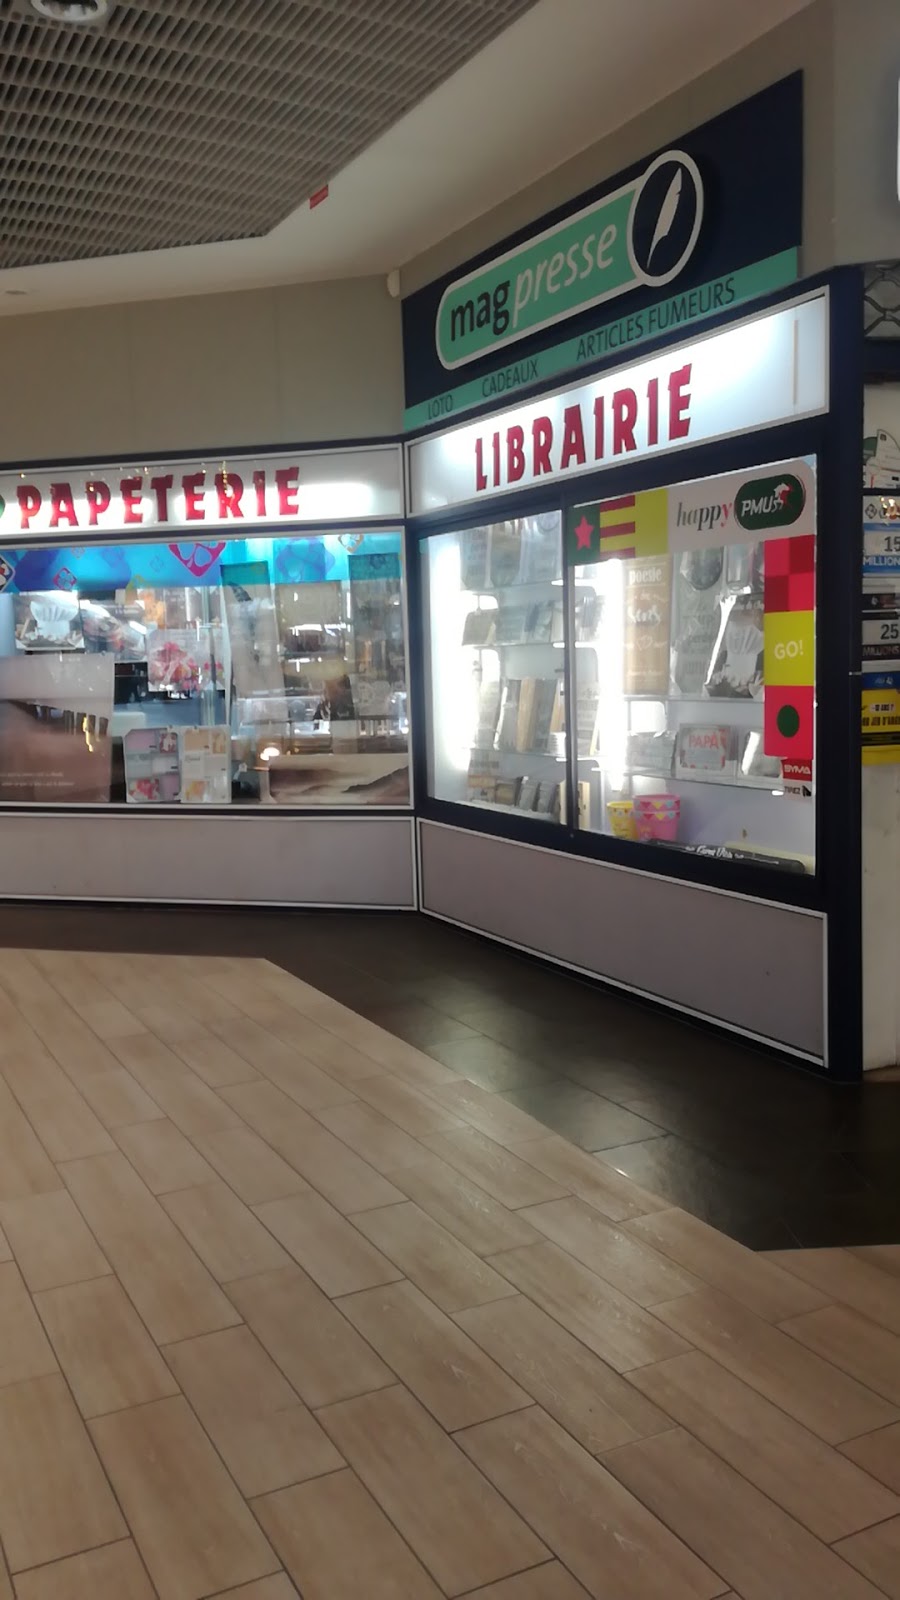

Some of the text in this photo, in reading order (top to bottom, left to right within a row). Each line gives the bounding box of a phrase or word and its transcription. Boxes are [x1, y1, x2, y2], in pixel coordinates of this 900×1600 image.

[427, 276, 736, 420] LOTO CADEAUX ARTICLES FUMEURS
[474, 363, 693, 493] LIBRAIRIE
[16, 467, 300, 529] PAPETERIE
[677, 502, 733, 531] happy
[774, 640, 804, 661] GO!
[880, 624, 899, 640] 25
